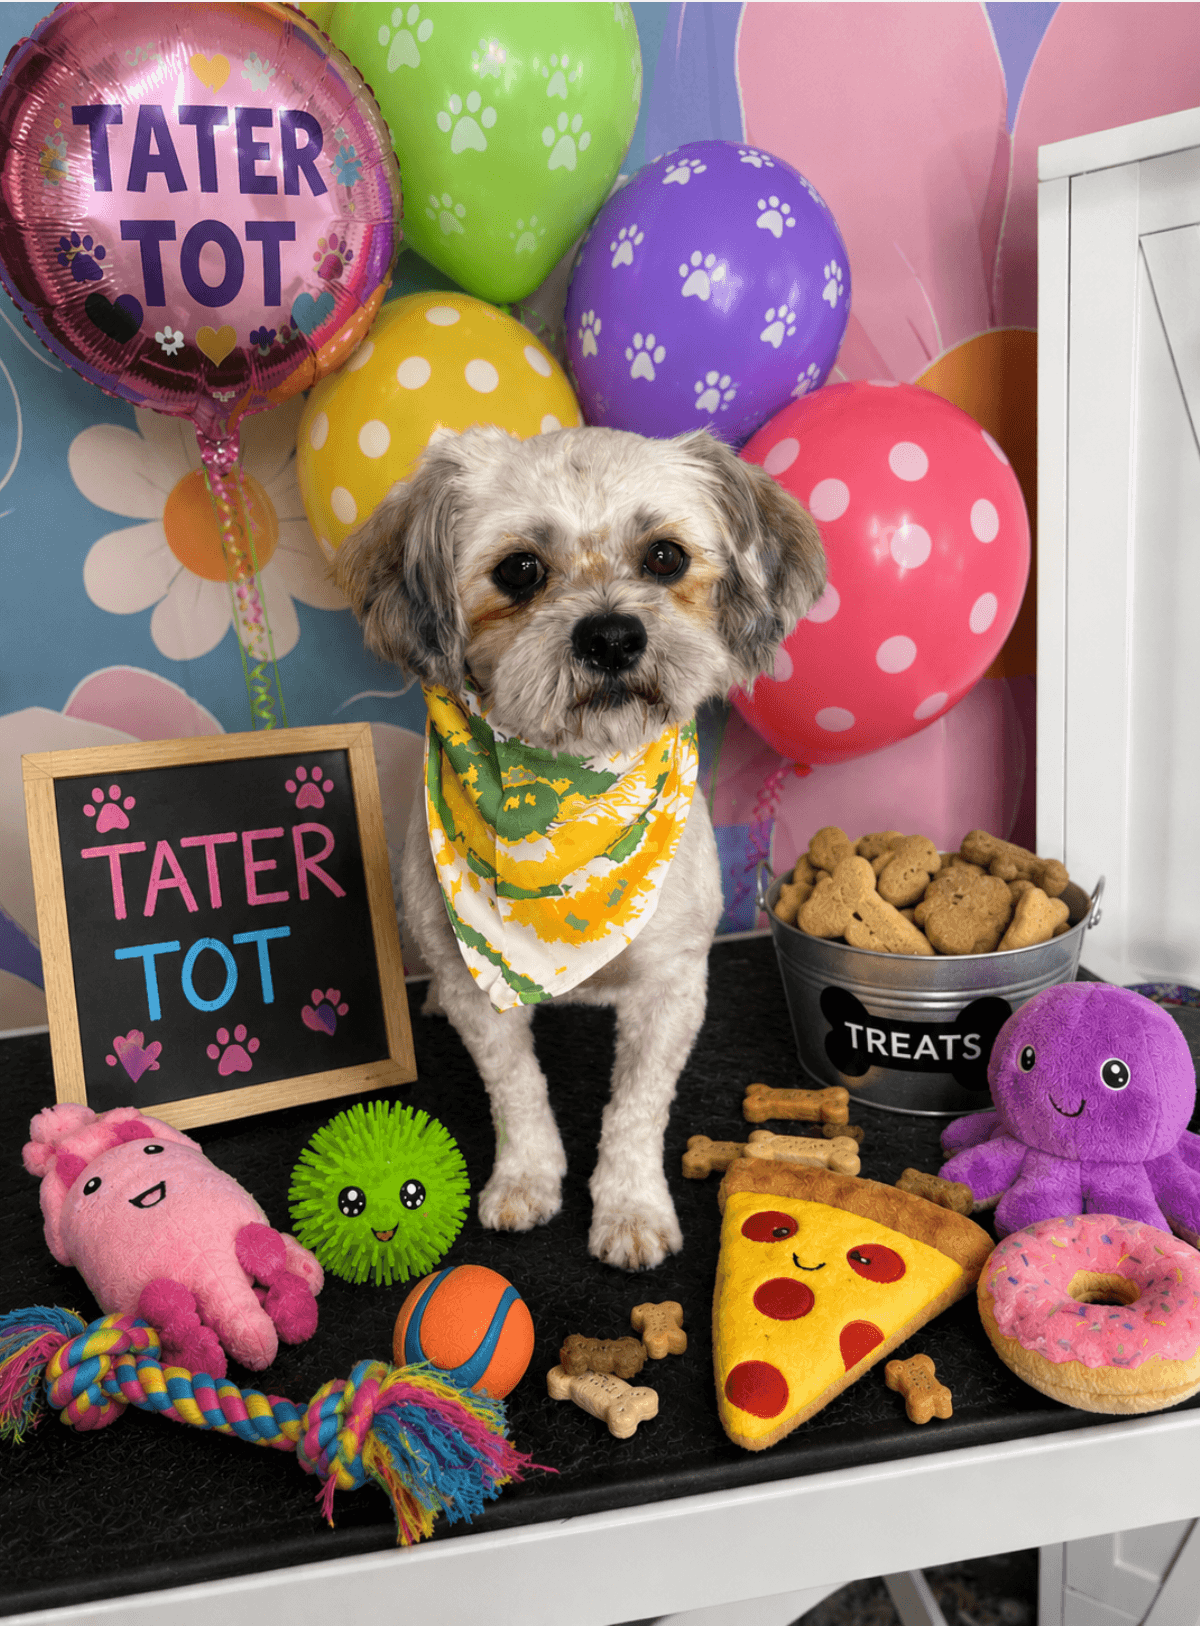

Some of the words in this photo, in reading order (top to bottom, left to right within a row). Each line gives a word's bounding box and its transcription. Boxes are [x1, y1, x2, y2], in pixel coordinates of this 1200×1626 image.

[71, 104, 329, 197] TATER
[120, 219, 296, 307] TOT
[80, 822, 347, 920] TATER
[114, 925, 291, 1021] TOT
[844, 1021, 981, 1060] TREATS
